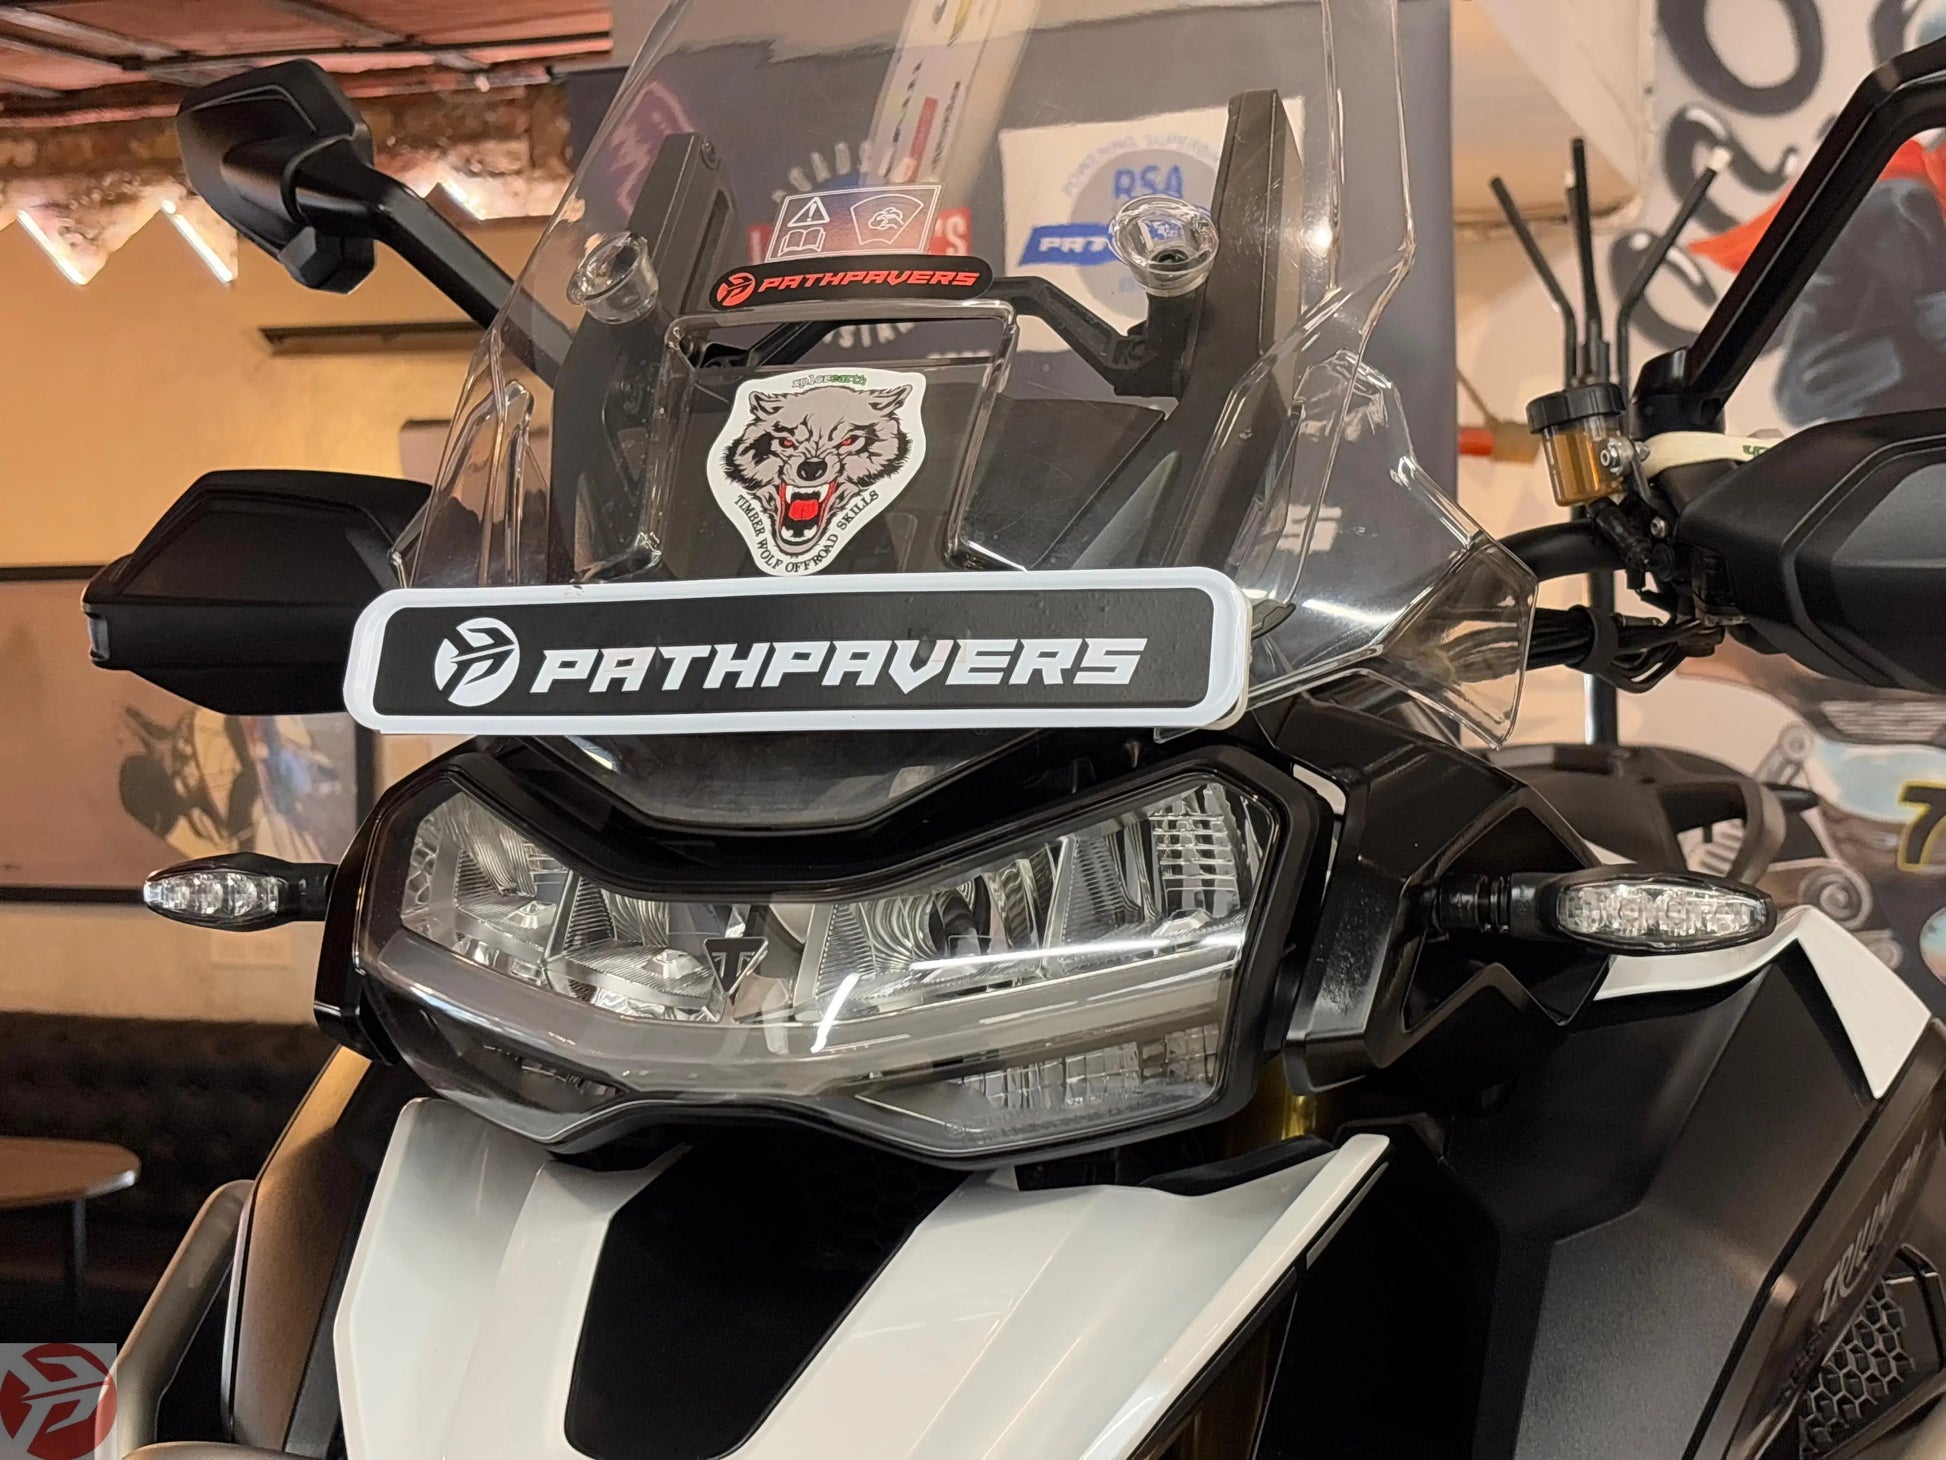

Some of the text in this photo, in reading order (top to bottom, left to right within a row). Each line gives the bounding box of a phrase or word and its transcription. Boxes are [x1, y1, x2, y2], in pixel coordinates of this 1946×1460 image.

[757, 269, 980, 293] PATHPAVERS
[733, 490, 880, 573] TIMBER WOLF OFFROAD SKILLS
[529, 637, 1149, 695] PATHPAVERS
